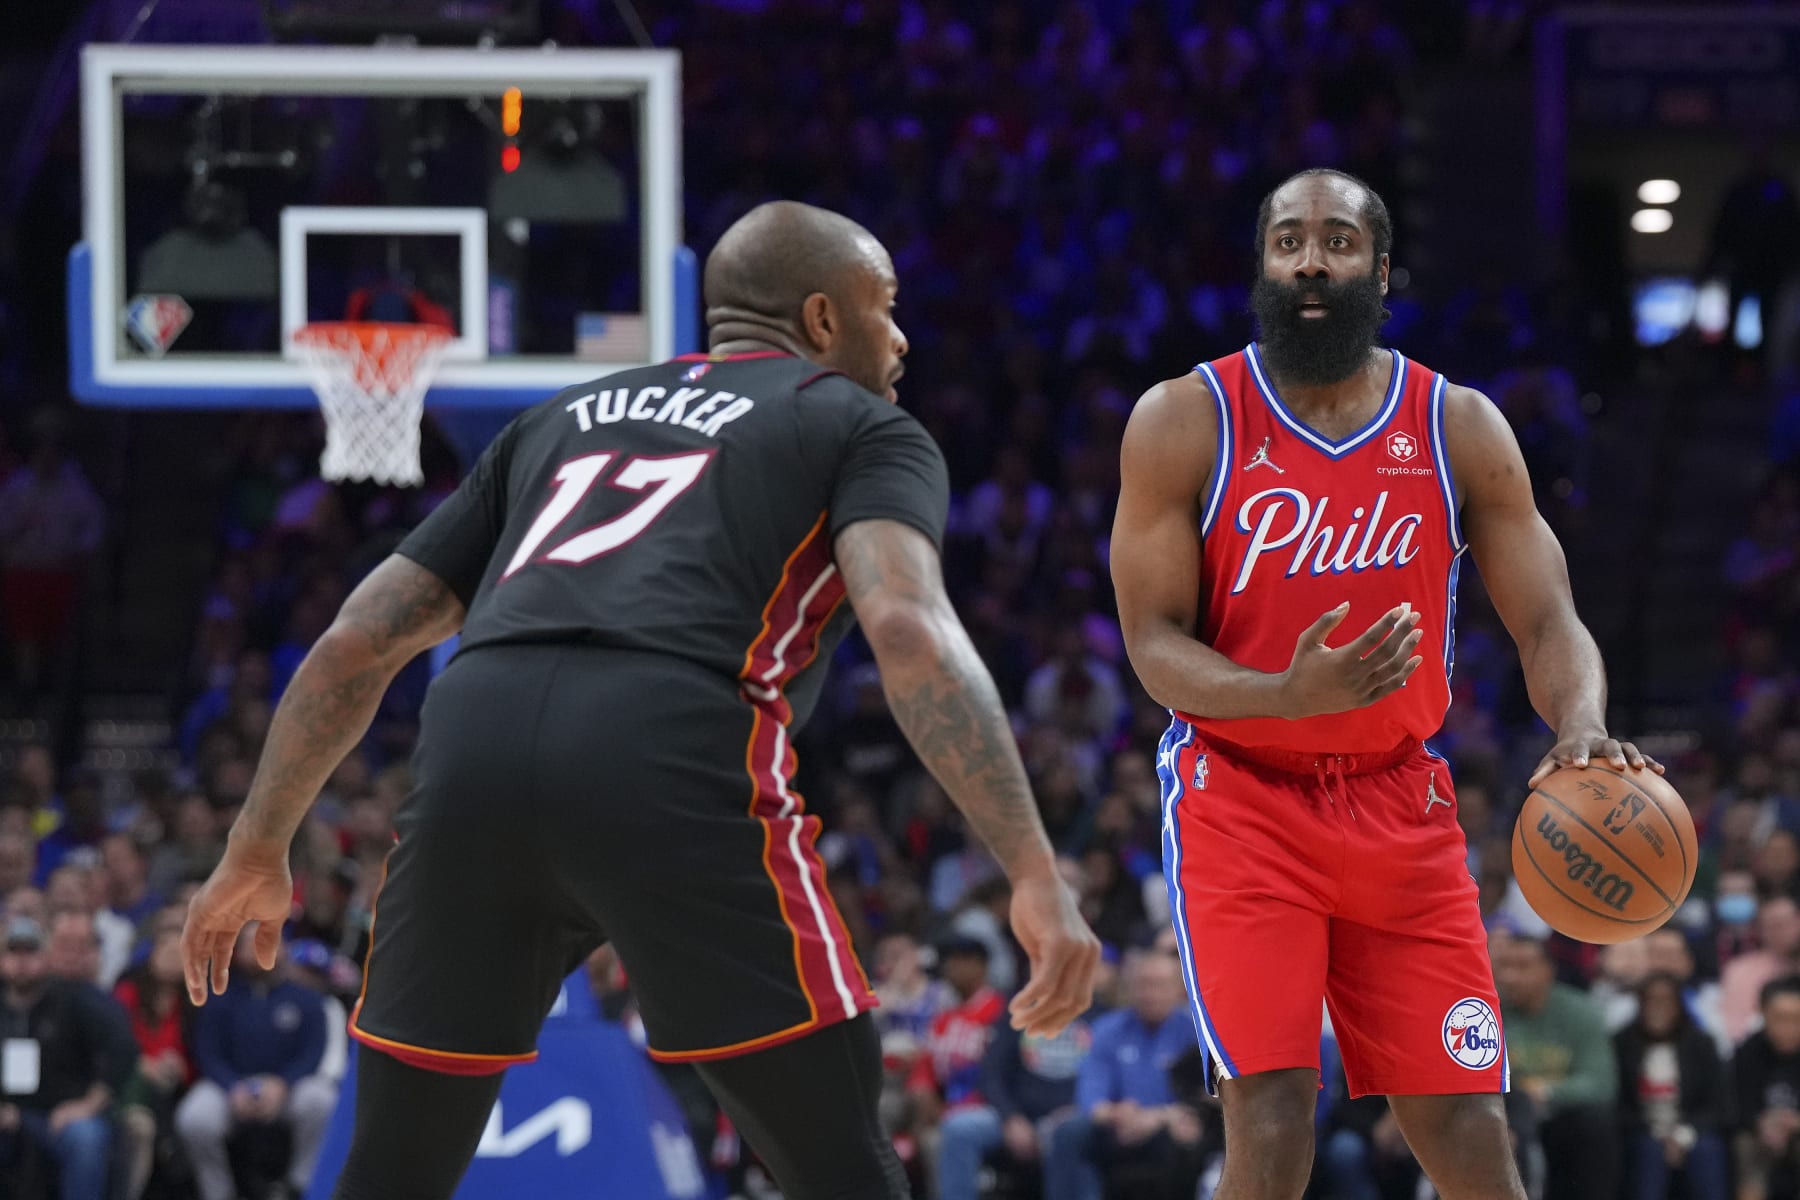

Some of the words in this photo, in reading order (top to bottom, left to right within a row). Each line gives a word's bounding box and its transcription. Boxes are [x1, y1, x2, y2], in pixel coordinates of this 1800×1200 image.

[565, 386, 754, 437] TUCKER
[1376, 467, 1433, 476] crypto.com
[498, 448, 719, 584] 17
[1230, 487, 1423, 596] Phila
[1537, 812, 1635, 912] Wilson
[1450, 1025, 1497, 1051] 76ers
